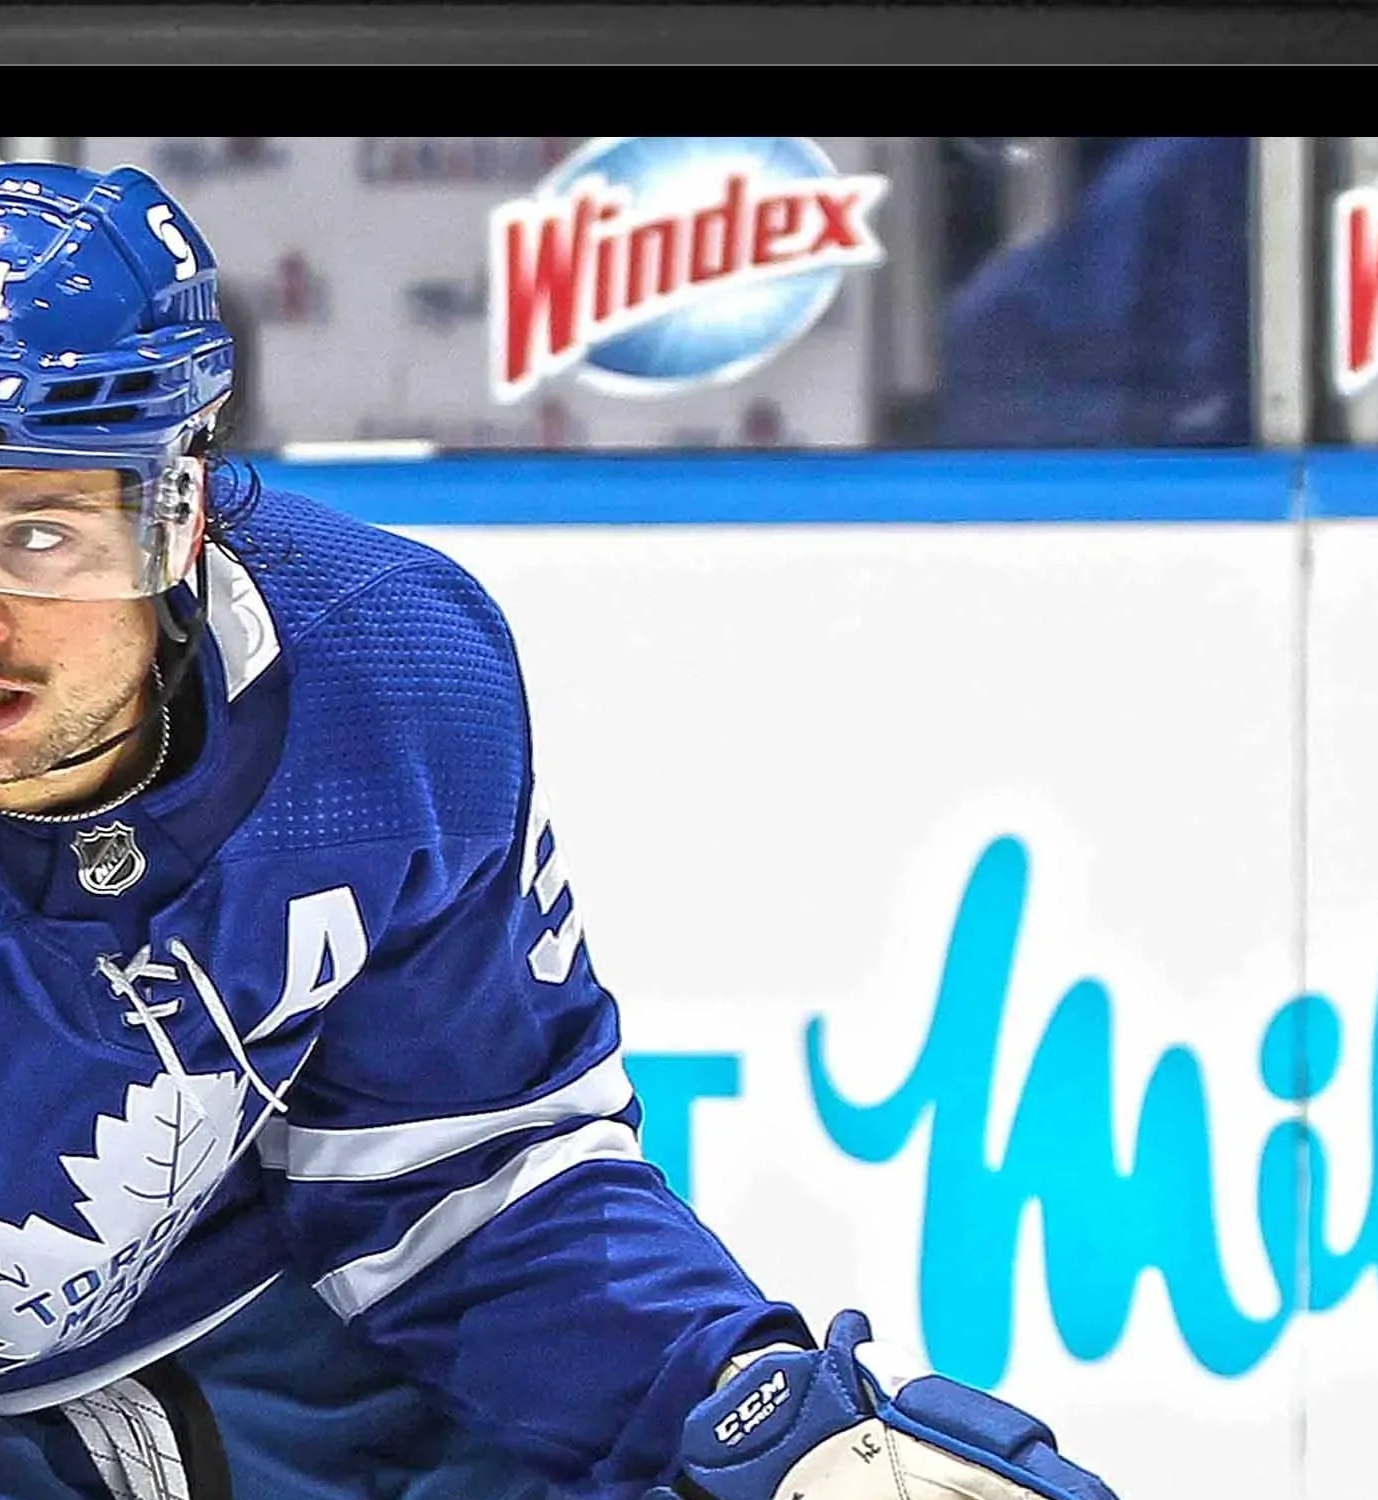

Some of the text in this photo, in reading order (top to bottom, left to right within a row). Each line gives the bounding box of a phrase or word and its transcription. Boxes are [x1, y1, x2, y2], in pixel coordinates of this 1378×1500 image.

[503, 173, 863, 386] Windex
[242, 884, 368, 1044] A
[714, 1370, 786, 1441] CCM
